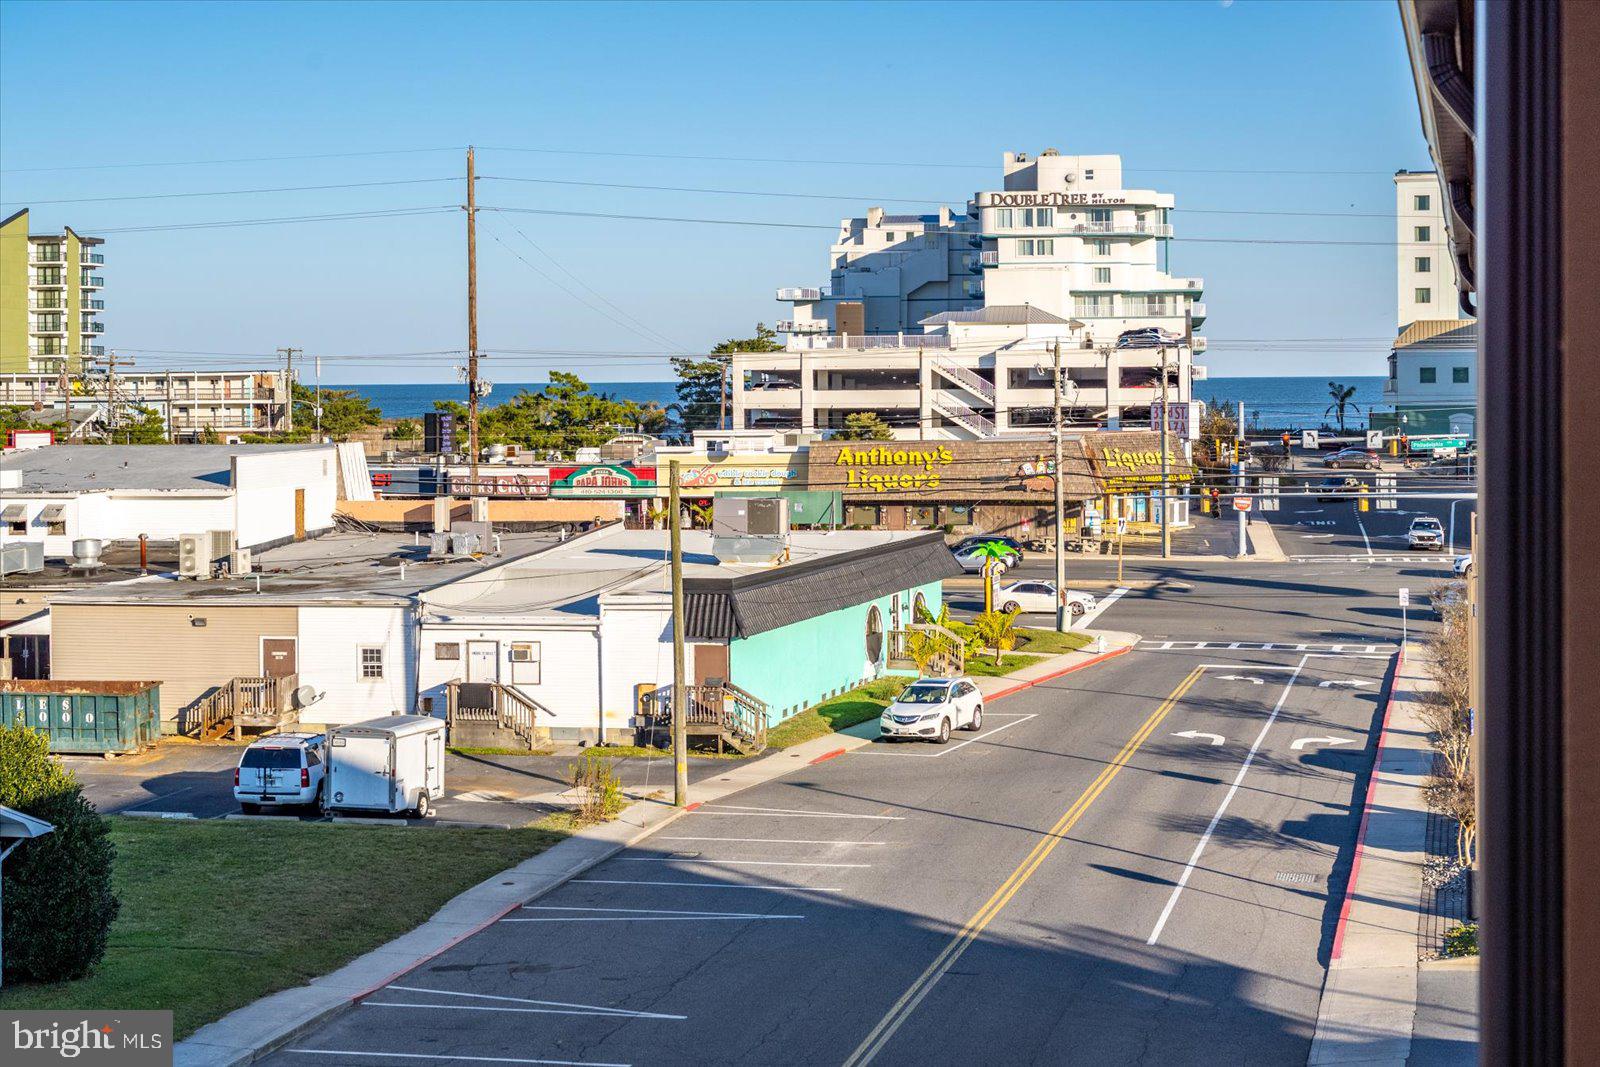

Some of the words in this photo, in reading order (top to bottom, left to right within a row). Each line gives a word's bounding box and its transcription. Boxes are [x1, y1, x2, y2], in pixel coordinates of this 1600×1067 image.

[1154, 420, 1187, 434] PAZA
[836, 445, 953, 471] Anthony's
[1102, 447, 1176, 472] Liquors
[576, 476, 597, 487] PAPA
[743, 468, 768, 478] cookie
[770, 467, 797, 479] dough
[846, 469, 941, 492] Liquors
